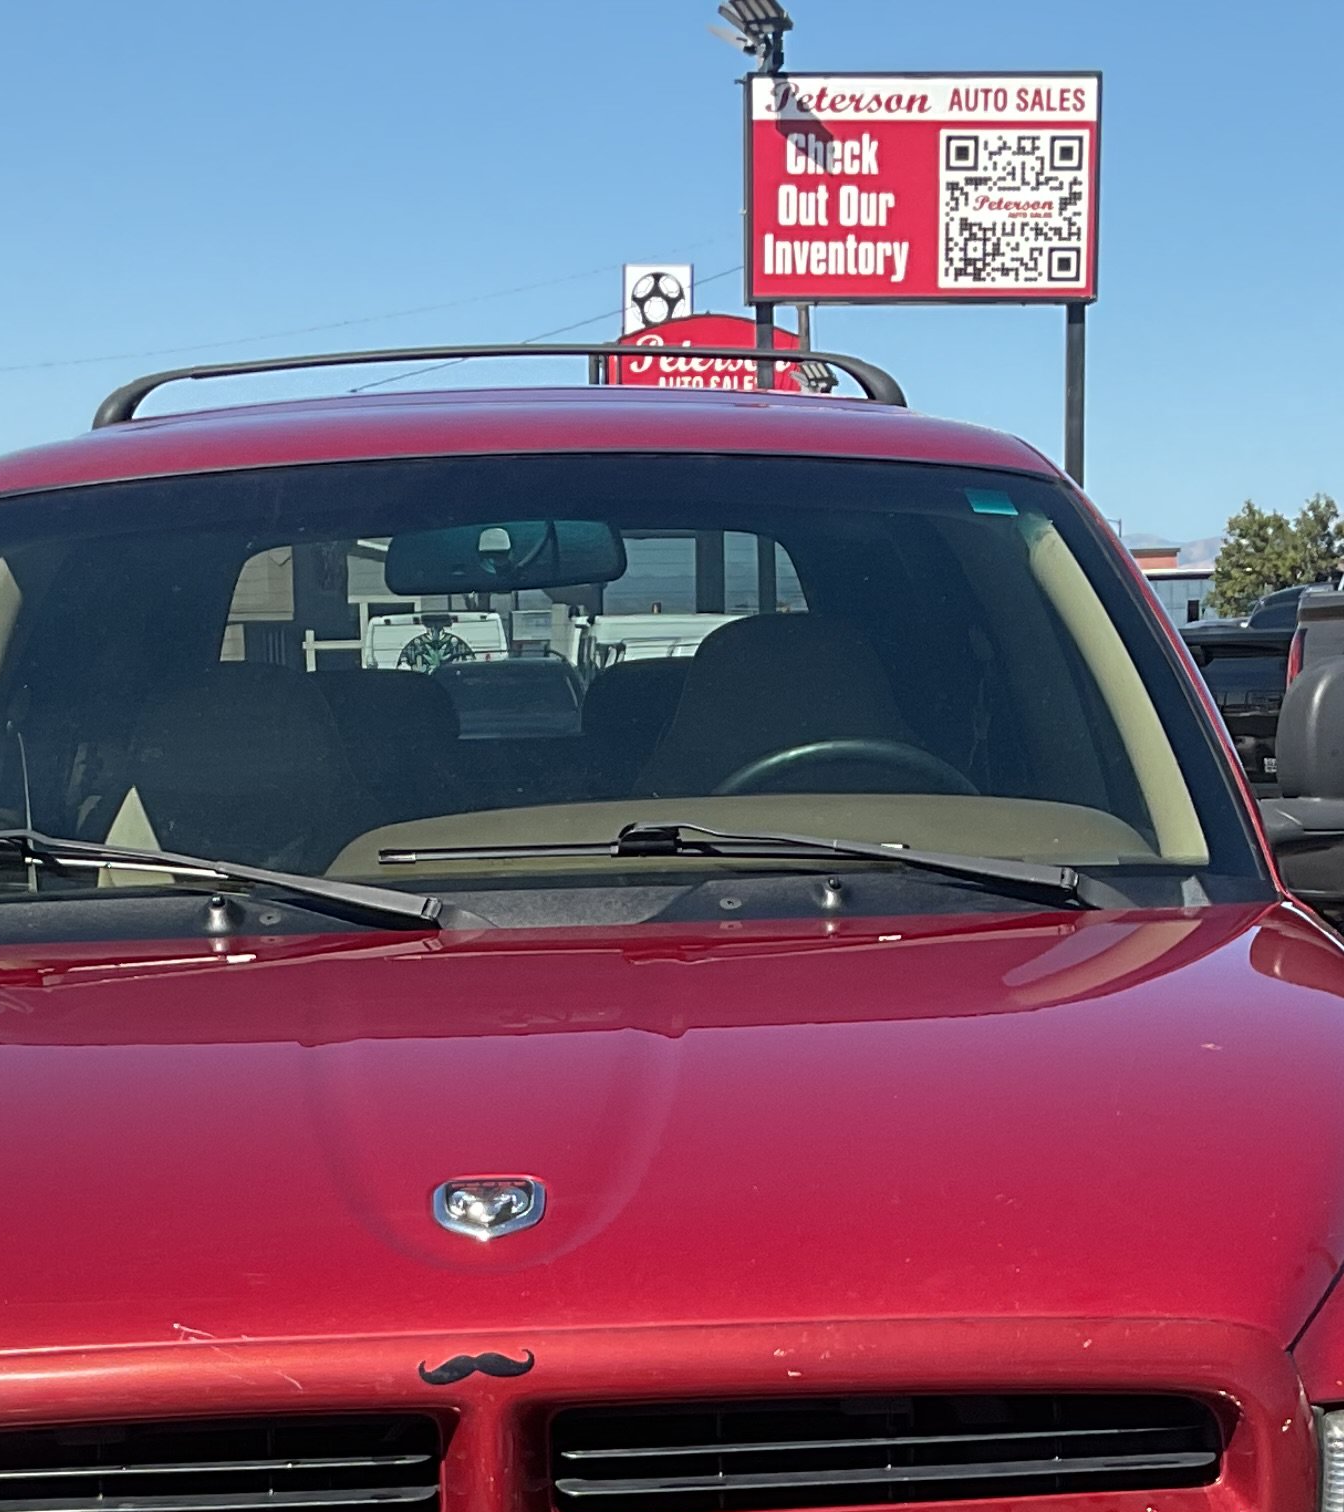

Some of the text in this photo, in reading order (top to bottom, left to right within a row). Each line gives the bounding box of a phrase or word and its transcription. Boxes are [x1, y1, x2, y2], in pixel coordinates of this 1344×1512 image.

[765, 81, 1086, 114] Peterson AUTO SALES
[786, 133, 879, 175] Check
[778, 184, 895, 226] Out Our
[973, 195, 1054, 211] Peterson
[764, 233, 909, 282] Inventory
[709, 376, 758, 390] SALE
